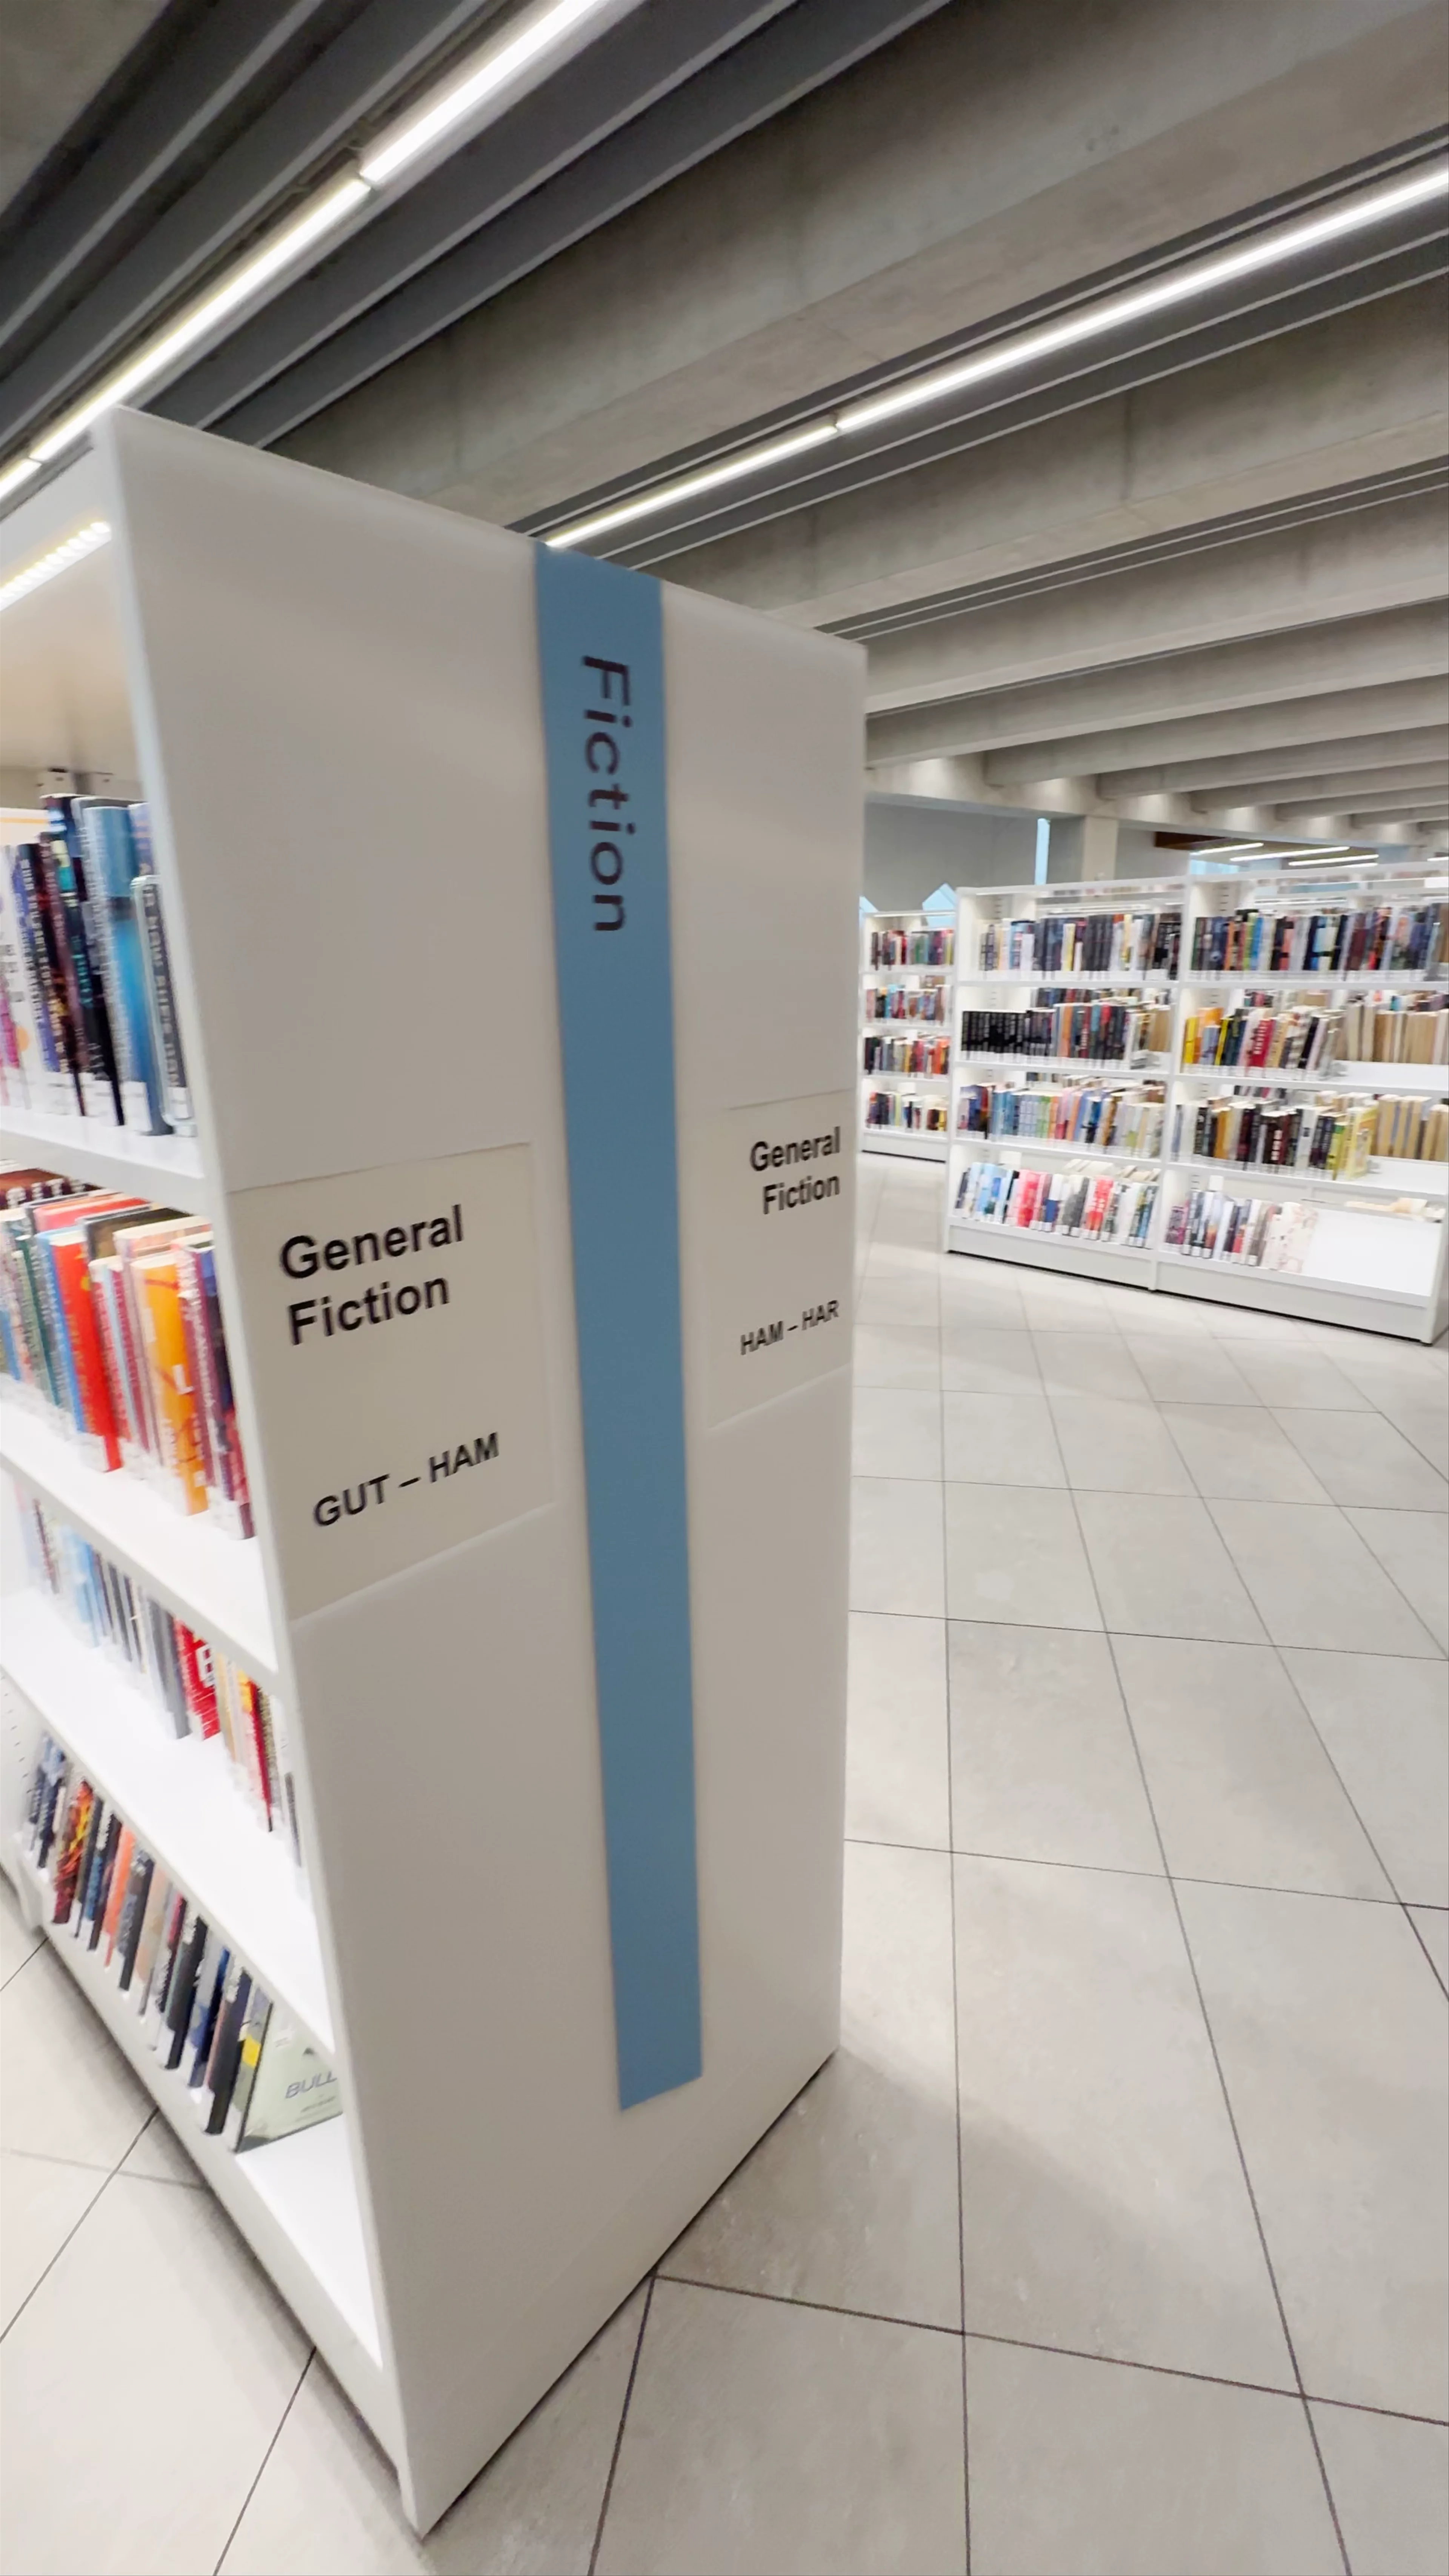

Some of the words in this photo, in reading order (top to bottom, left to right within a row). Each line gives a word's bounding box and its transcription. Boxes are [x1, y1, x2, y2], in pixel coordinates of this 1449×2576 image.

[581, 655, 637, 932] Fiction
[750, 1126, 841, 1172] General
[762, 1175, 840, 1215] Fiction
[280, 1204, 465, 1280] General
[288, 1276, 450, 1346] Fiction
[740, 1321, 784, 1356] HAM
[801, 1300, 840, 1330] HAR
[314, 1473, 390, 1528] GUT
[428, 1432, 500, 1483] HAM
